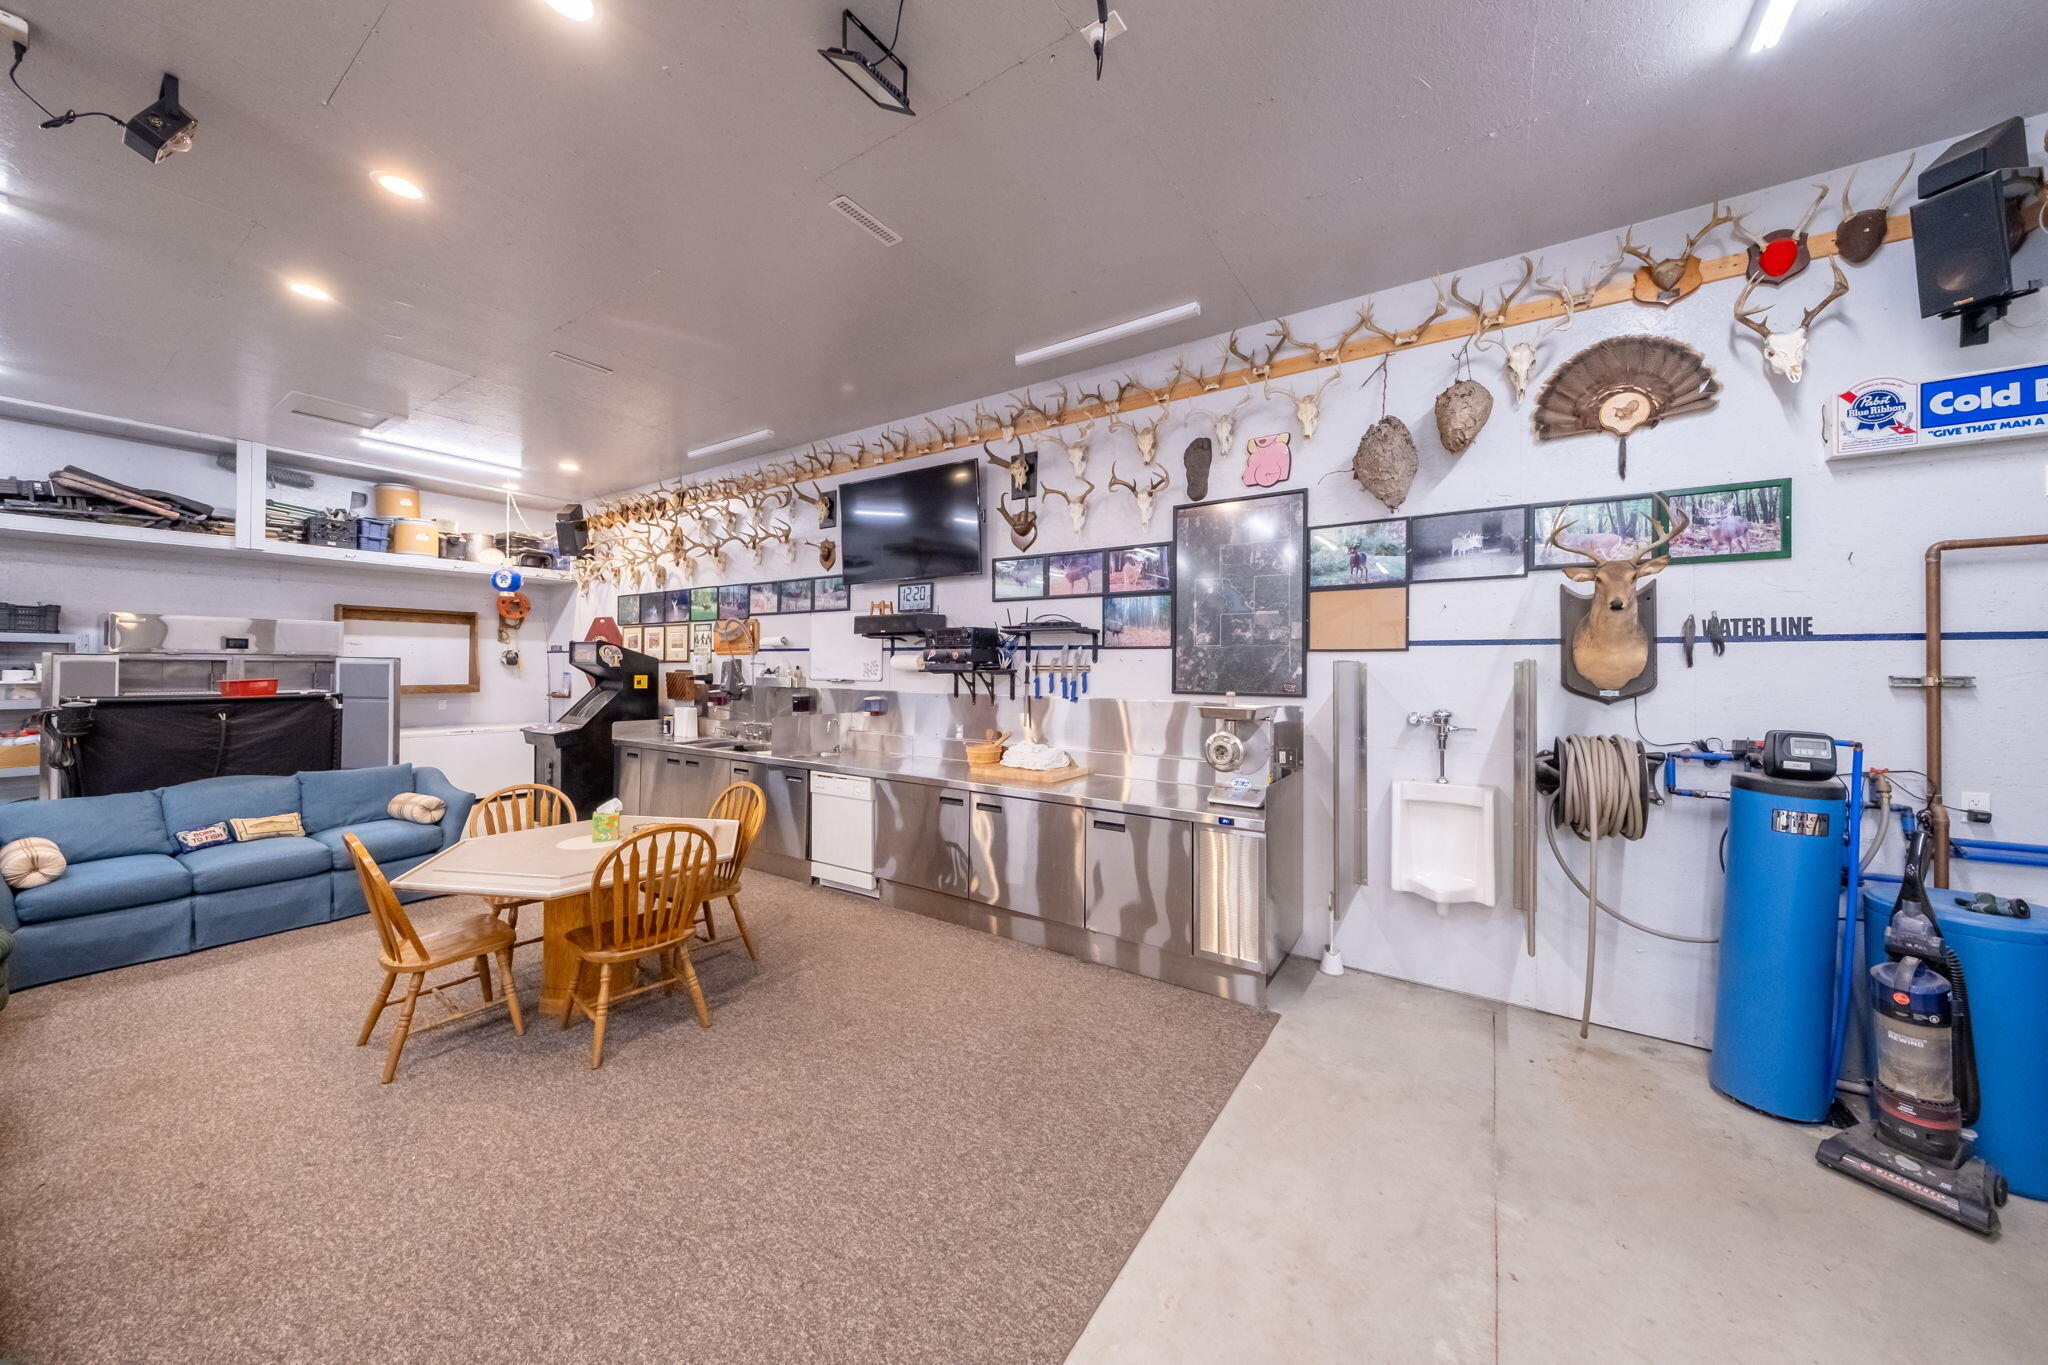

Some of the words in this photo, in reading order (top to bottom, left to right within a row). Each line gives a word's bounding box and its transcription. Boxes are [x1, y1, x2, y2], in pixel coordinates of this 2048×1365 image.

[1860, 394, 1891, 407] Pabst
[1929, 382, 2021, 415] Cold
[1849, 409, 1870, 417] Blue
[1870, 404, 1904, 414] Ribbon
[1966, 423, 1997, 433] THAT
[2000, 419, 2031, 429] MAN
[2034, 417, 2045, 425] A
[1771, 616, 1814, 636] LINE
[193, 828, 216, 837] BORN
[205, 832, 223, 841] FISH
